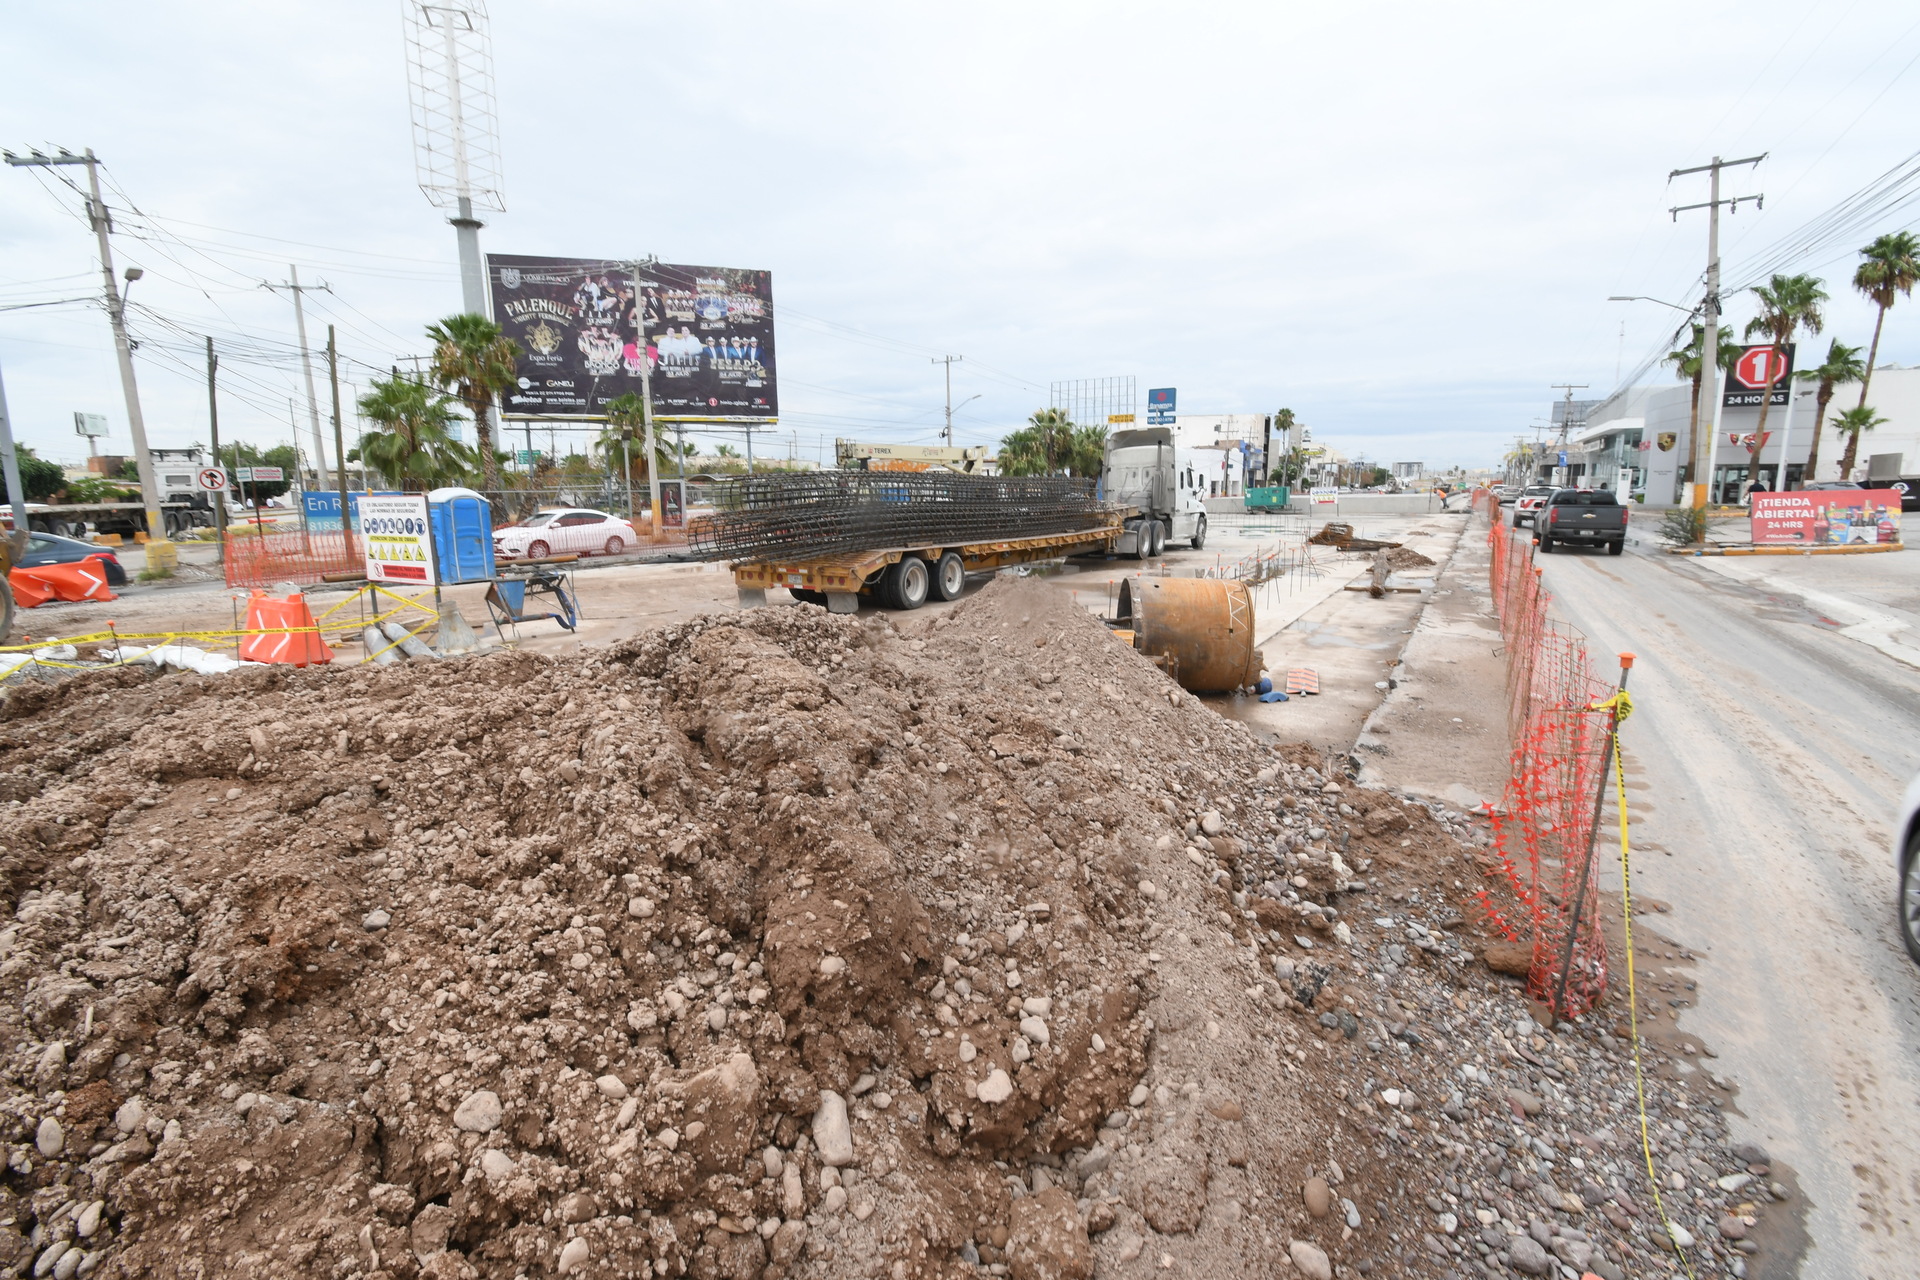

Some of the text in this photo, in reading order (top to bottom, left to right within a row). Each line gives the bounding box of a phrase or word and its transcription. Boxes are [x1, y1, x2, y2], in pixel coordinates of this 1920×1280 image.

[504, 298, 575, 320] PALENQUE
[529, 354, 563, 363] Expo Feria
[1752, 353, 1767, 382] 1
[1727, 396, 1742, 404] 24
[307, 497, 328, 510] En
[332, 497, 359, 510] Ren
[1758, 498, 1811, 509] ¡TIENDA
[1754, 509, 1815, 519] ABIERTA!
[310, 521, 359, 531] 818365
[1782, 521, 1804, 529] HRS
